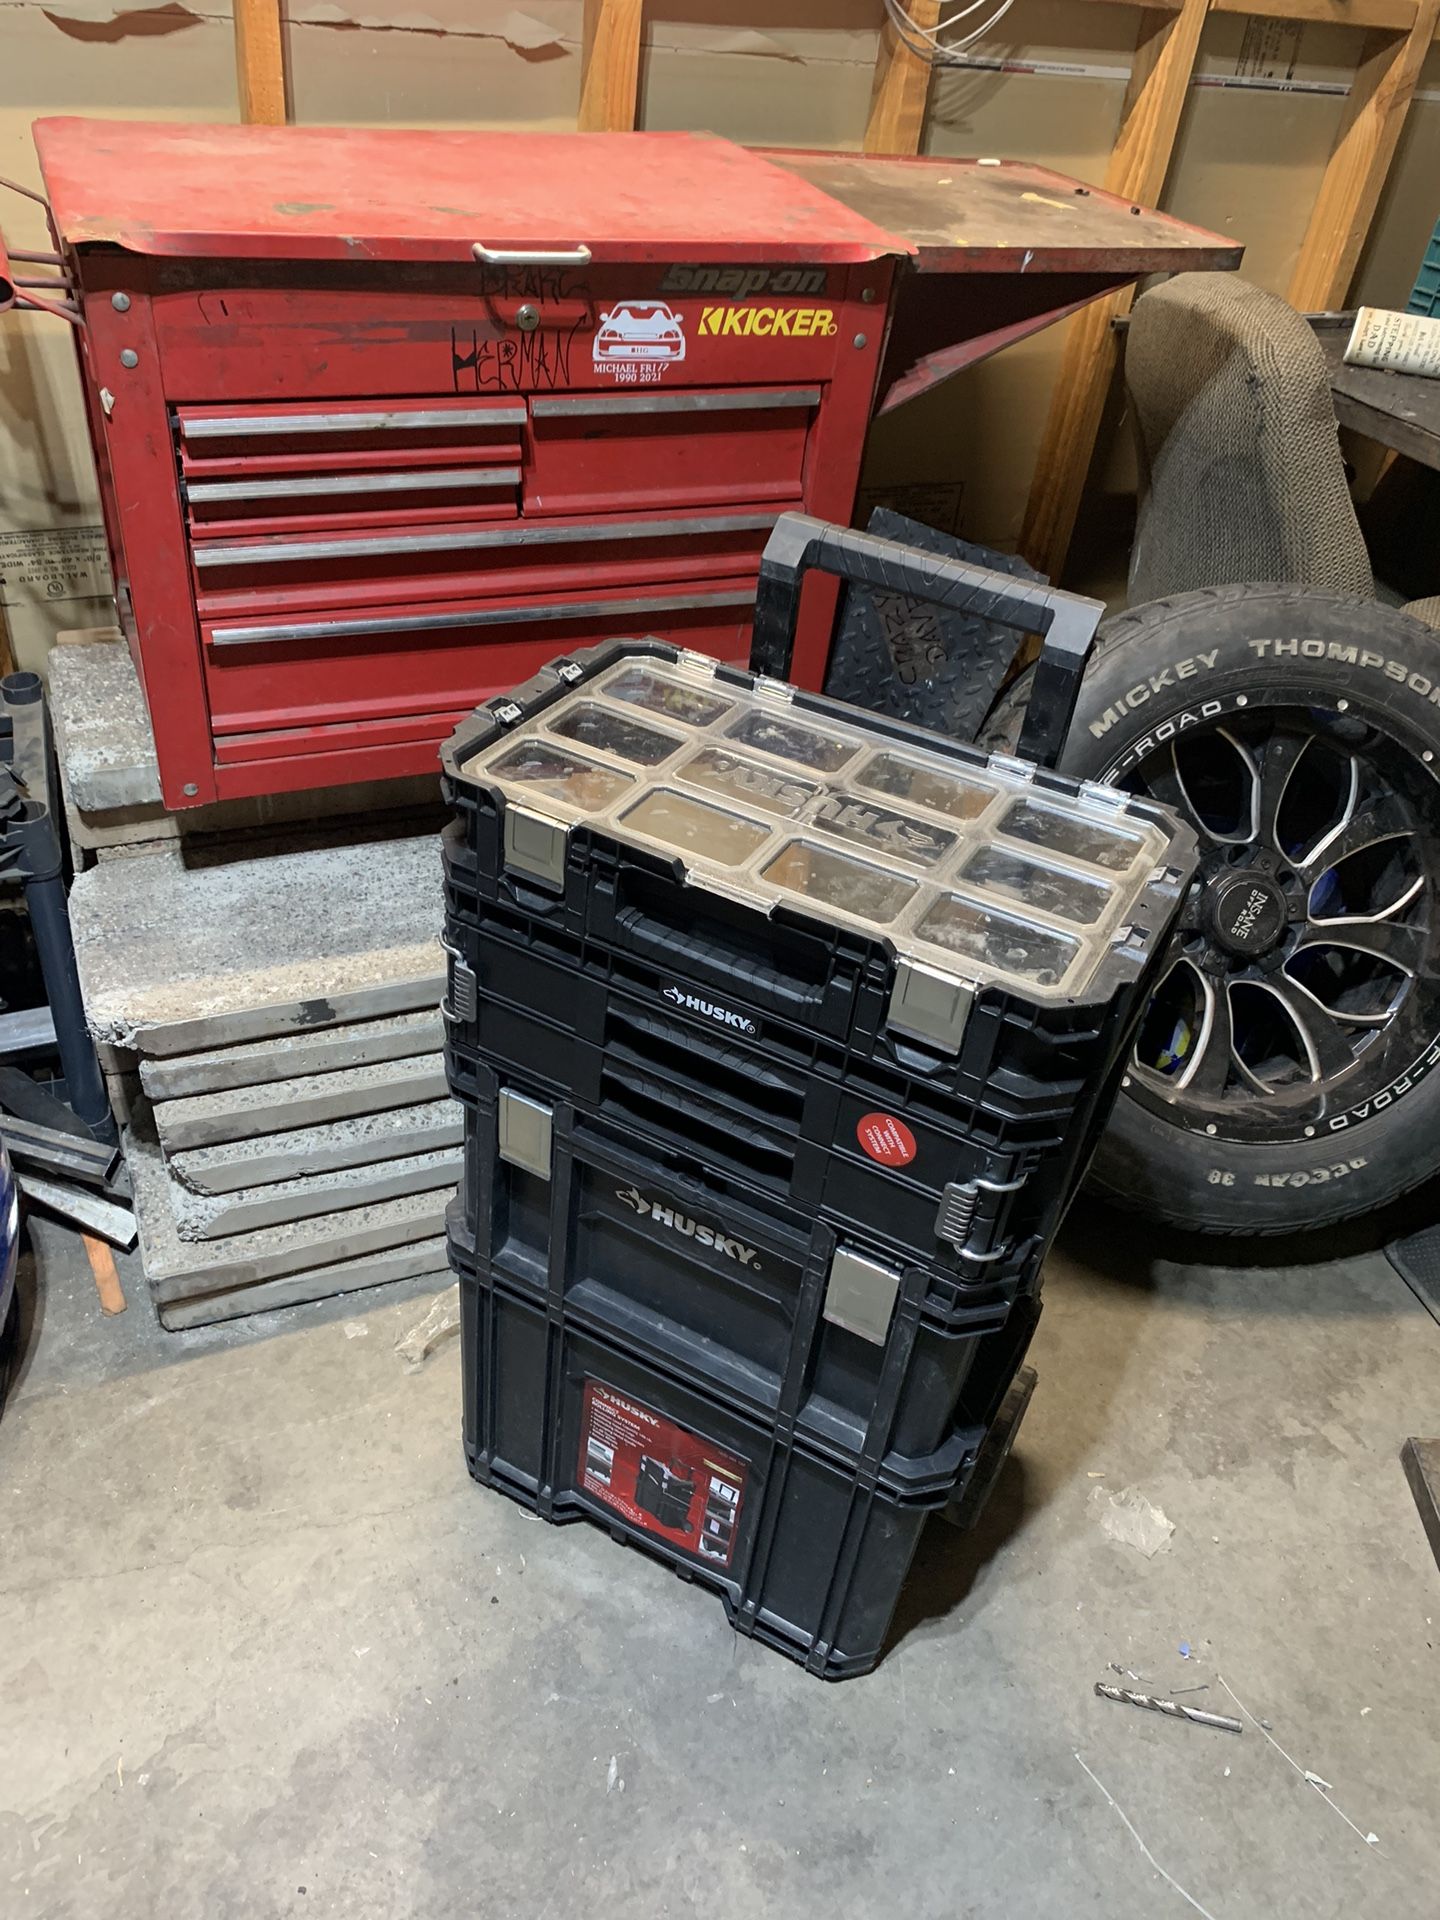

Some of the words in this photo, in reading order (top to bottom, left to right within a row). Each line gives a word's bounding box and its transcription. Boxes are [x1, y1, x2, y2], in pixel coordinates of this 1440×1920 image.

[720, 307, 835, 336] KICKER
[1367, 324, 1381, 349] DAD
[452, 318, 582, 392] HERMAN
[593, 363, 638, 374] MICHAEL
[614, 372, 638, 383] 1990
[639, 371, 662, 383] 2021
[1087, 648, 1220, 739] MICKEY
[1230, 908, 1248, 935] ROAD
[1235, 892, 1269, 940] INSANE
[685, 994, 751, 1032] HUSKY
[864, 1127, 882, 1154] SYSTEM
[871, 1124, 892, 1156] CONNECT
[883, 1129, 896, 1148] WITH
[885, 1118, 910, 1158] COMPATIBLE
[651, 1201, 757, 1265] HUSKY
[609, 1395, 659, 1427] HUSKY
